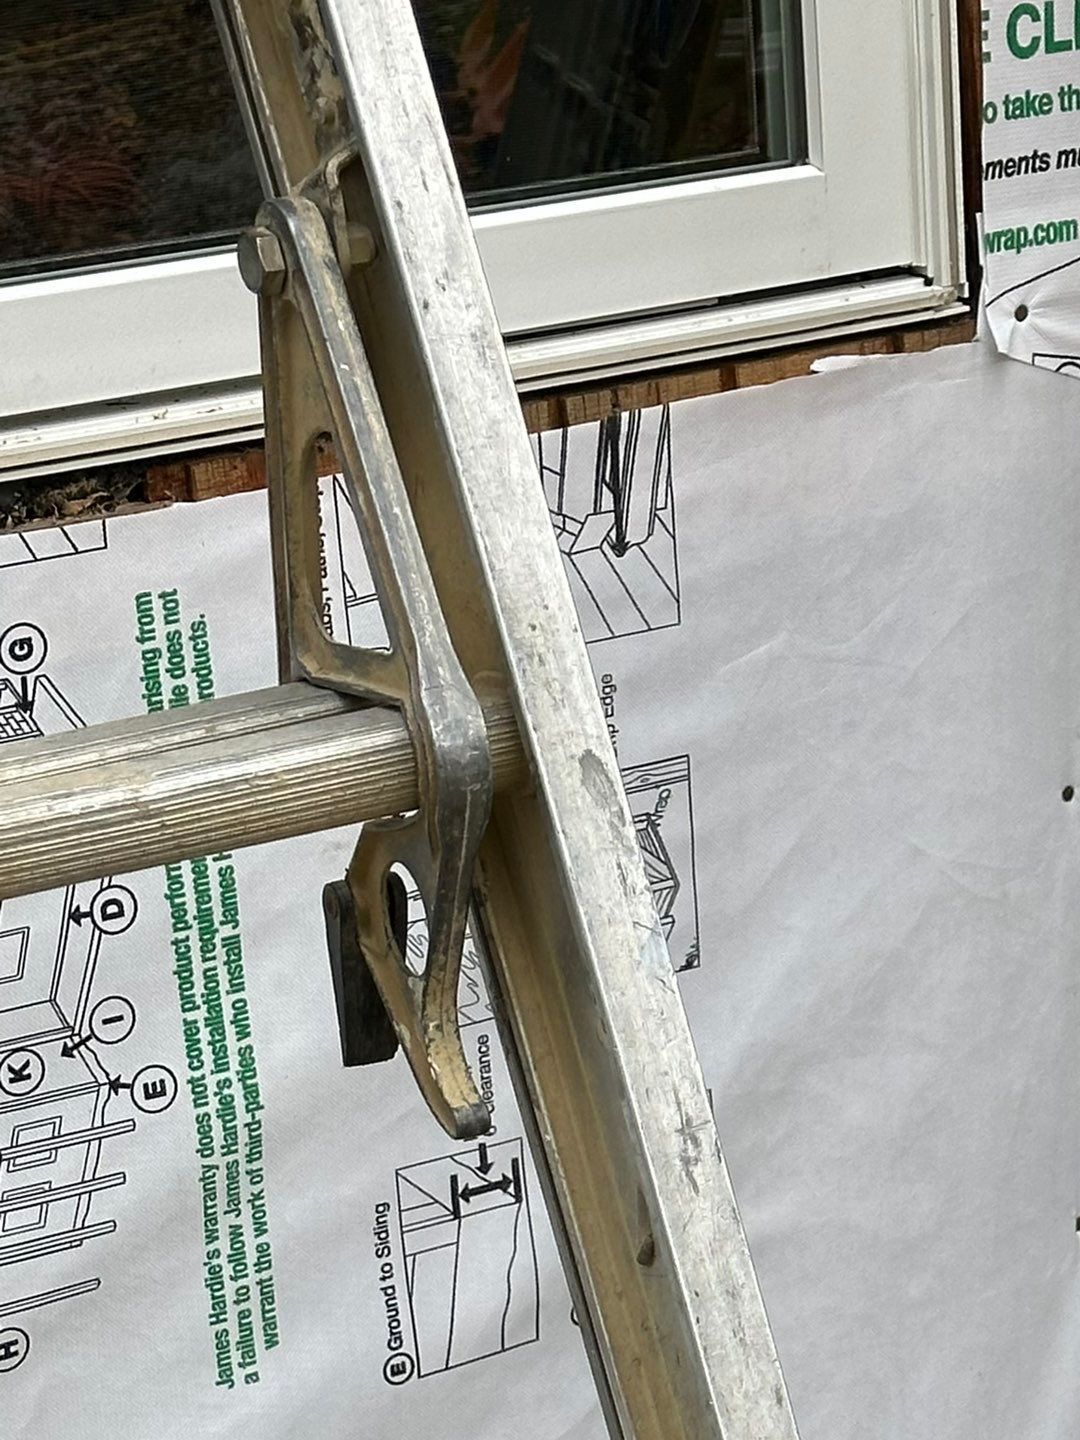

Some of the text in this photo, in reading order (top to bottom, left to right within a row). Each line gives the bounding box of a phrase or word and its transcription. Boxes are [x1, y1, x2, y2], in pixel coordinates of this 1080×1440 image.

[1003, 90, 1054, 120] take
[982, 150, 1051, 181] ments
[135, 592, 156, 644] from
[158, 588, 180, 625] not
[165, 630, 186, 679] does
[217, 865, 240, 930] James
[171, 935, 200, 1013] product
[222, 934, 245, 993] install
[182, 1018, 204, 1072] cover
[200, 966, 230, 1074] installation
[230, 998, 251, 1040] who
[186, 1075, 209, 1108] not
[212, 1078, 239, 1156] Hardie's
[237, 1045, 264, 1164] third-parties
[193, 1112, 214, 1159] does
[223, 1159, 242, 1218] James
[244, 1164, 264, 1185] of
[199, 1164, 220, 1245] warranty
[247, 1190, 269, 1238] work
[373, 1202, 390, 1259] Siding
[227, 1224, 249, 1281] follow
[254, 1241, 272, 1273] the
[379, 1262, 394, 1280] to
[203, 1248, 228, 1326] Hardie's
[232, 1285, 251, 1304] to
[256, 1276, 280, 1350] warrant
[234, 1309, 257, 1369] failure
[380, 1285, 403, 1351] Ground
[215, 1329, 235, 1389] James
[243, 1371, 260, 1385] a
